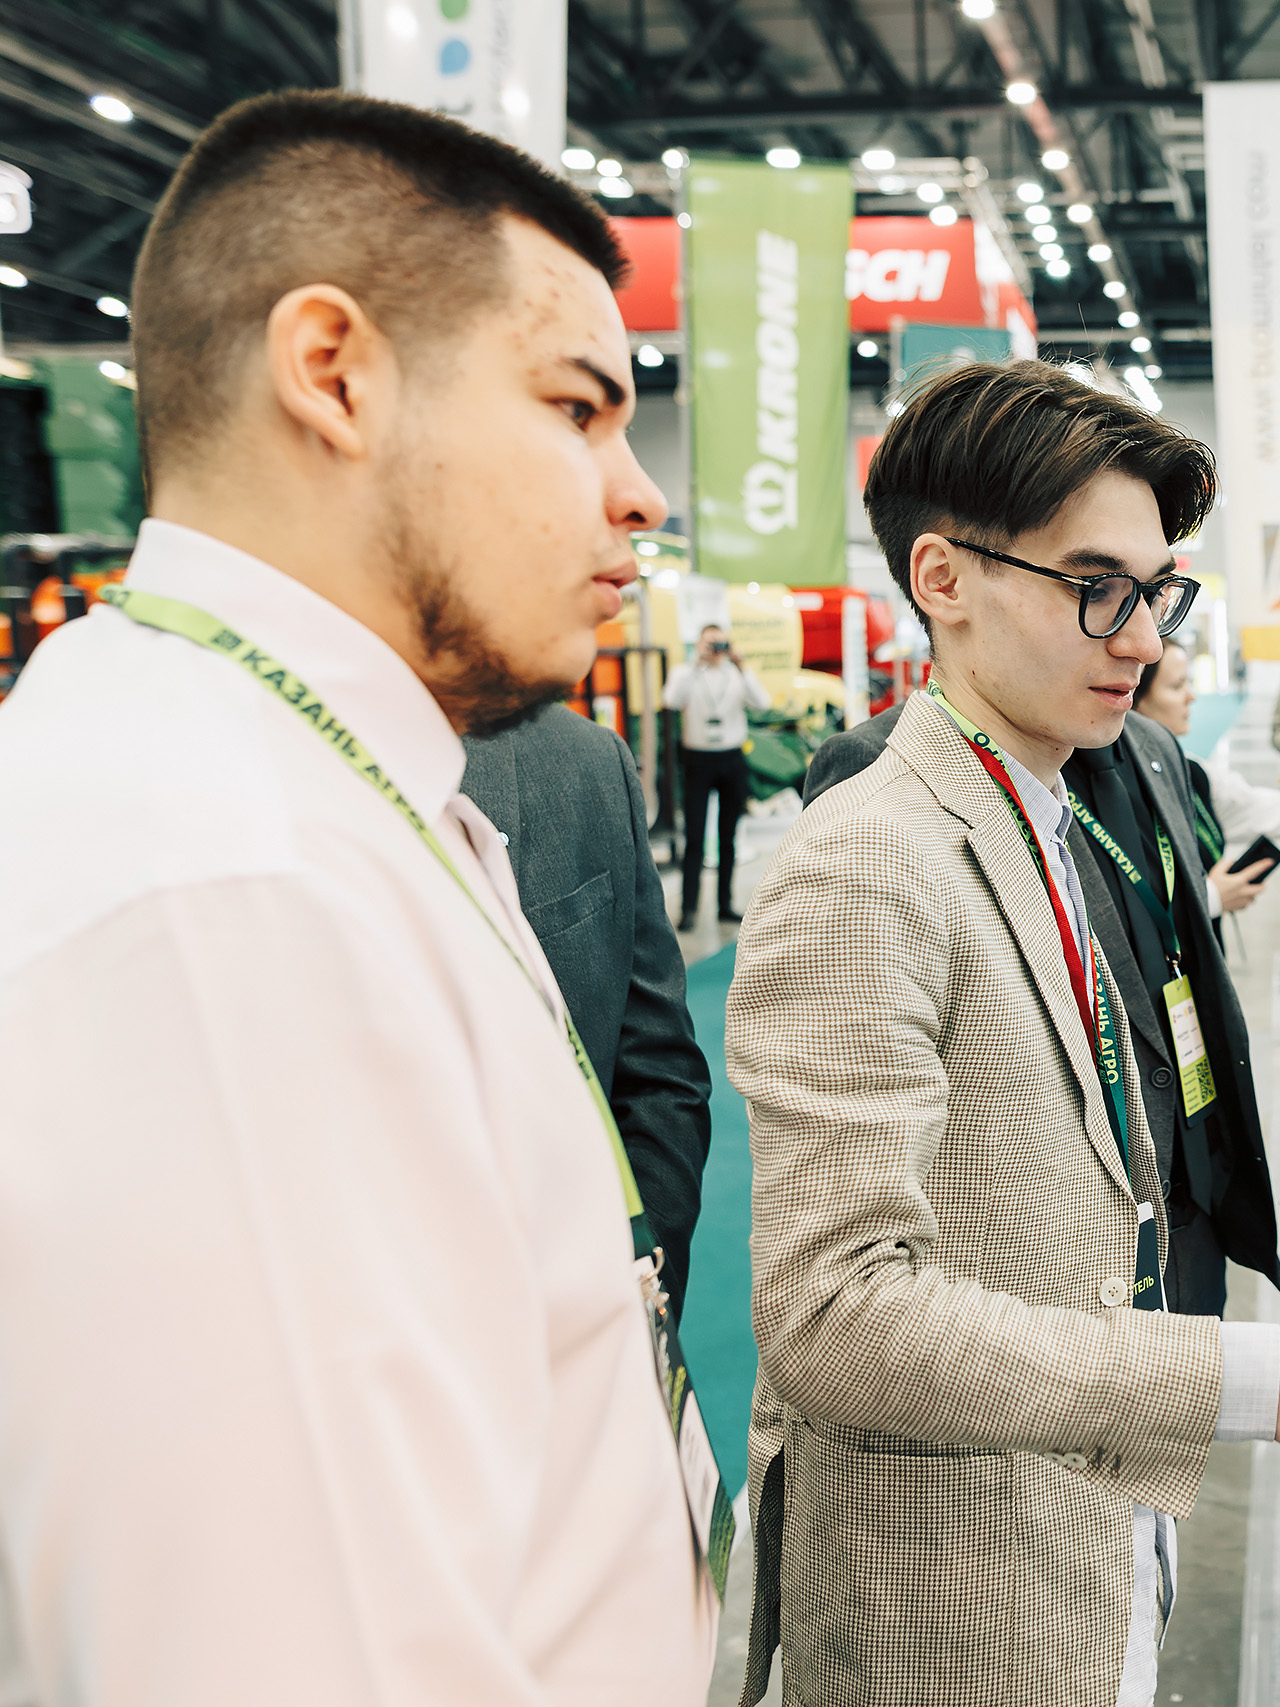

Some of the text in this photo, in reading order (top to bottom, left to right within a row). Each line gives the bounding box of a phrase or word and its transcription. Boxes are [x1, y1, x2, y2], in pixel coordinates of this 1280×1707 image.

[757, 230, 799, 463] KRONE
[242, 649, 357, 758] КАЗАНЬ
[1067, 791, 1135, 875] КАЗАНЬ АГРО
[1101, 1038, 1120, 1085] АГРО
